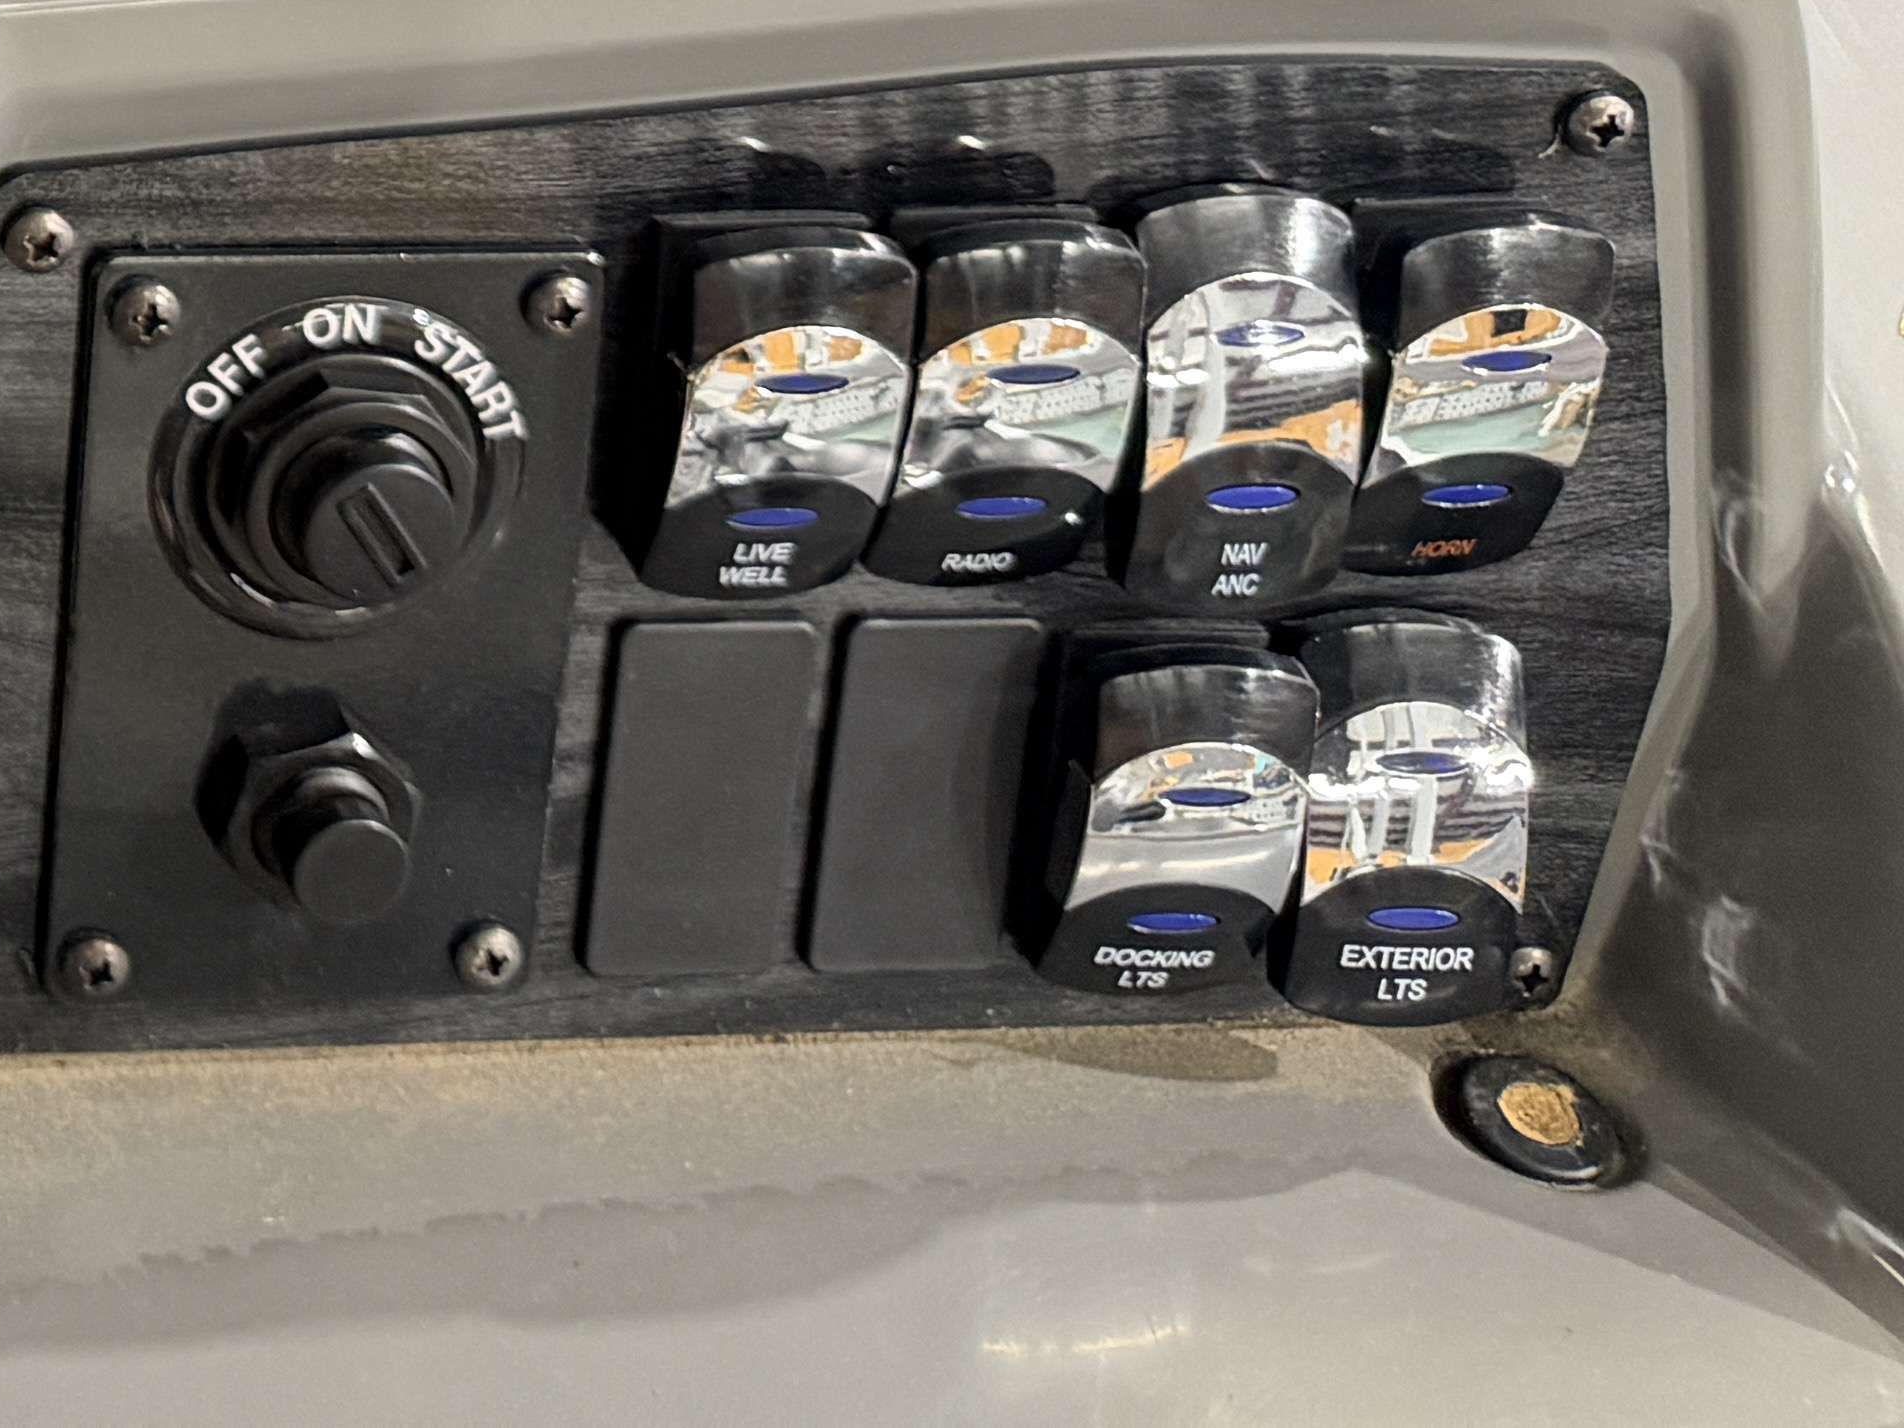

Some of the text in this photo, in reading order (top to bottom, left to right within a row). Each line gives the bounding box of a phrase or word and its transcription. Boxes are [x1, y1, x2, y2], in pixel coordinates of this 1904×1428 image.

[302, 304, 381, 349] ON
[184, 334, 273, 421] OFF
[414, 322, 530, 442] START
[733, 541, 795, 565] LIVE
[1221, 542, 1268, 566] NAV
[1410, 539, 1478, 559] HORN
[941, 551, 1017, 572] RADIO
[719, 566, 789, 588] WELL
[1211, 572, 1261, 595] ANC
[1093, 945, 1216, 969] DOCKING
[1339, 943, 1475, 972] EXTERIOR
[1117, 970, 1171, 989] LTS
[1376, 977, 1428, 1003] LTS
